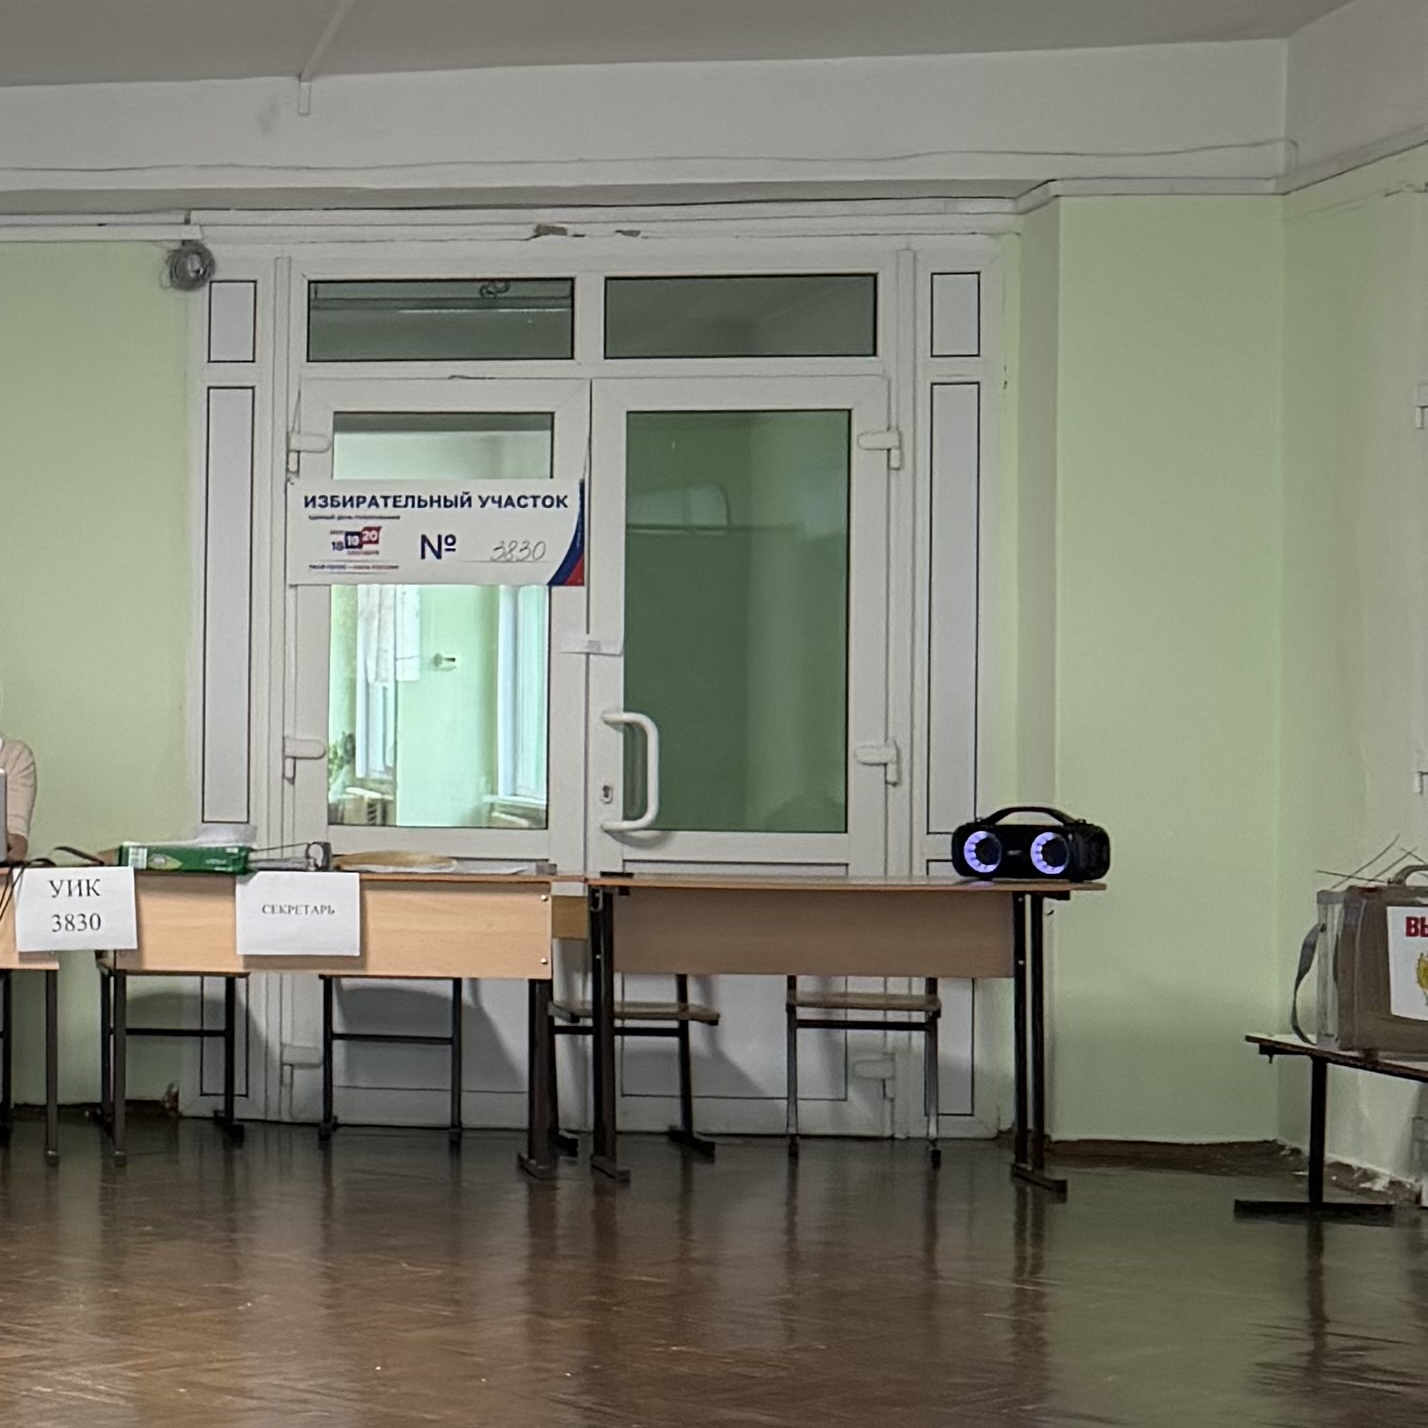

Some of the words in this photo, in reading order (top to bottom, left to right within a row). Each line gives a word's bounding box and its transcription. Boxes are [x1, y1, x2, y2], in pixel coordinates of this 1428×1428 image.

[304, 491, 472, 509] ИЗБИРАТЕЛЬНЫЙ
[479, 494, 568, 509] УЧАСТОК
[362, 530, 377, 542] 20
[420, 534, 457, 560] №
[489, 540, 546, 562] 3830
[49, 879, 101, 898] УИК
[261, 904, 335, 915] СЕКРЕТАРЬ
[51, 913, 102, 933] 3830
